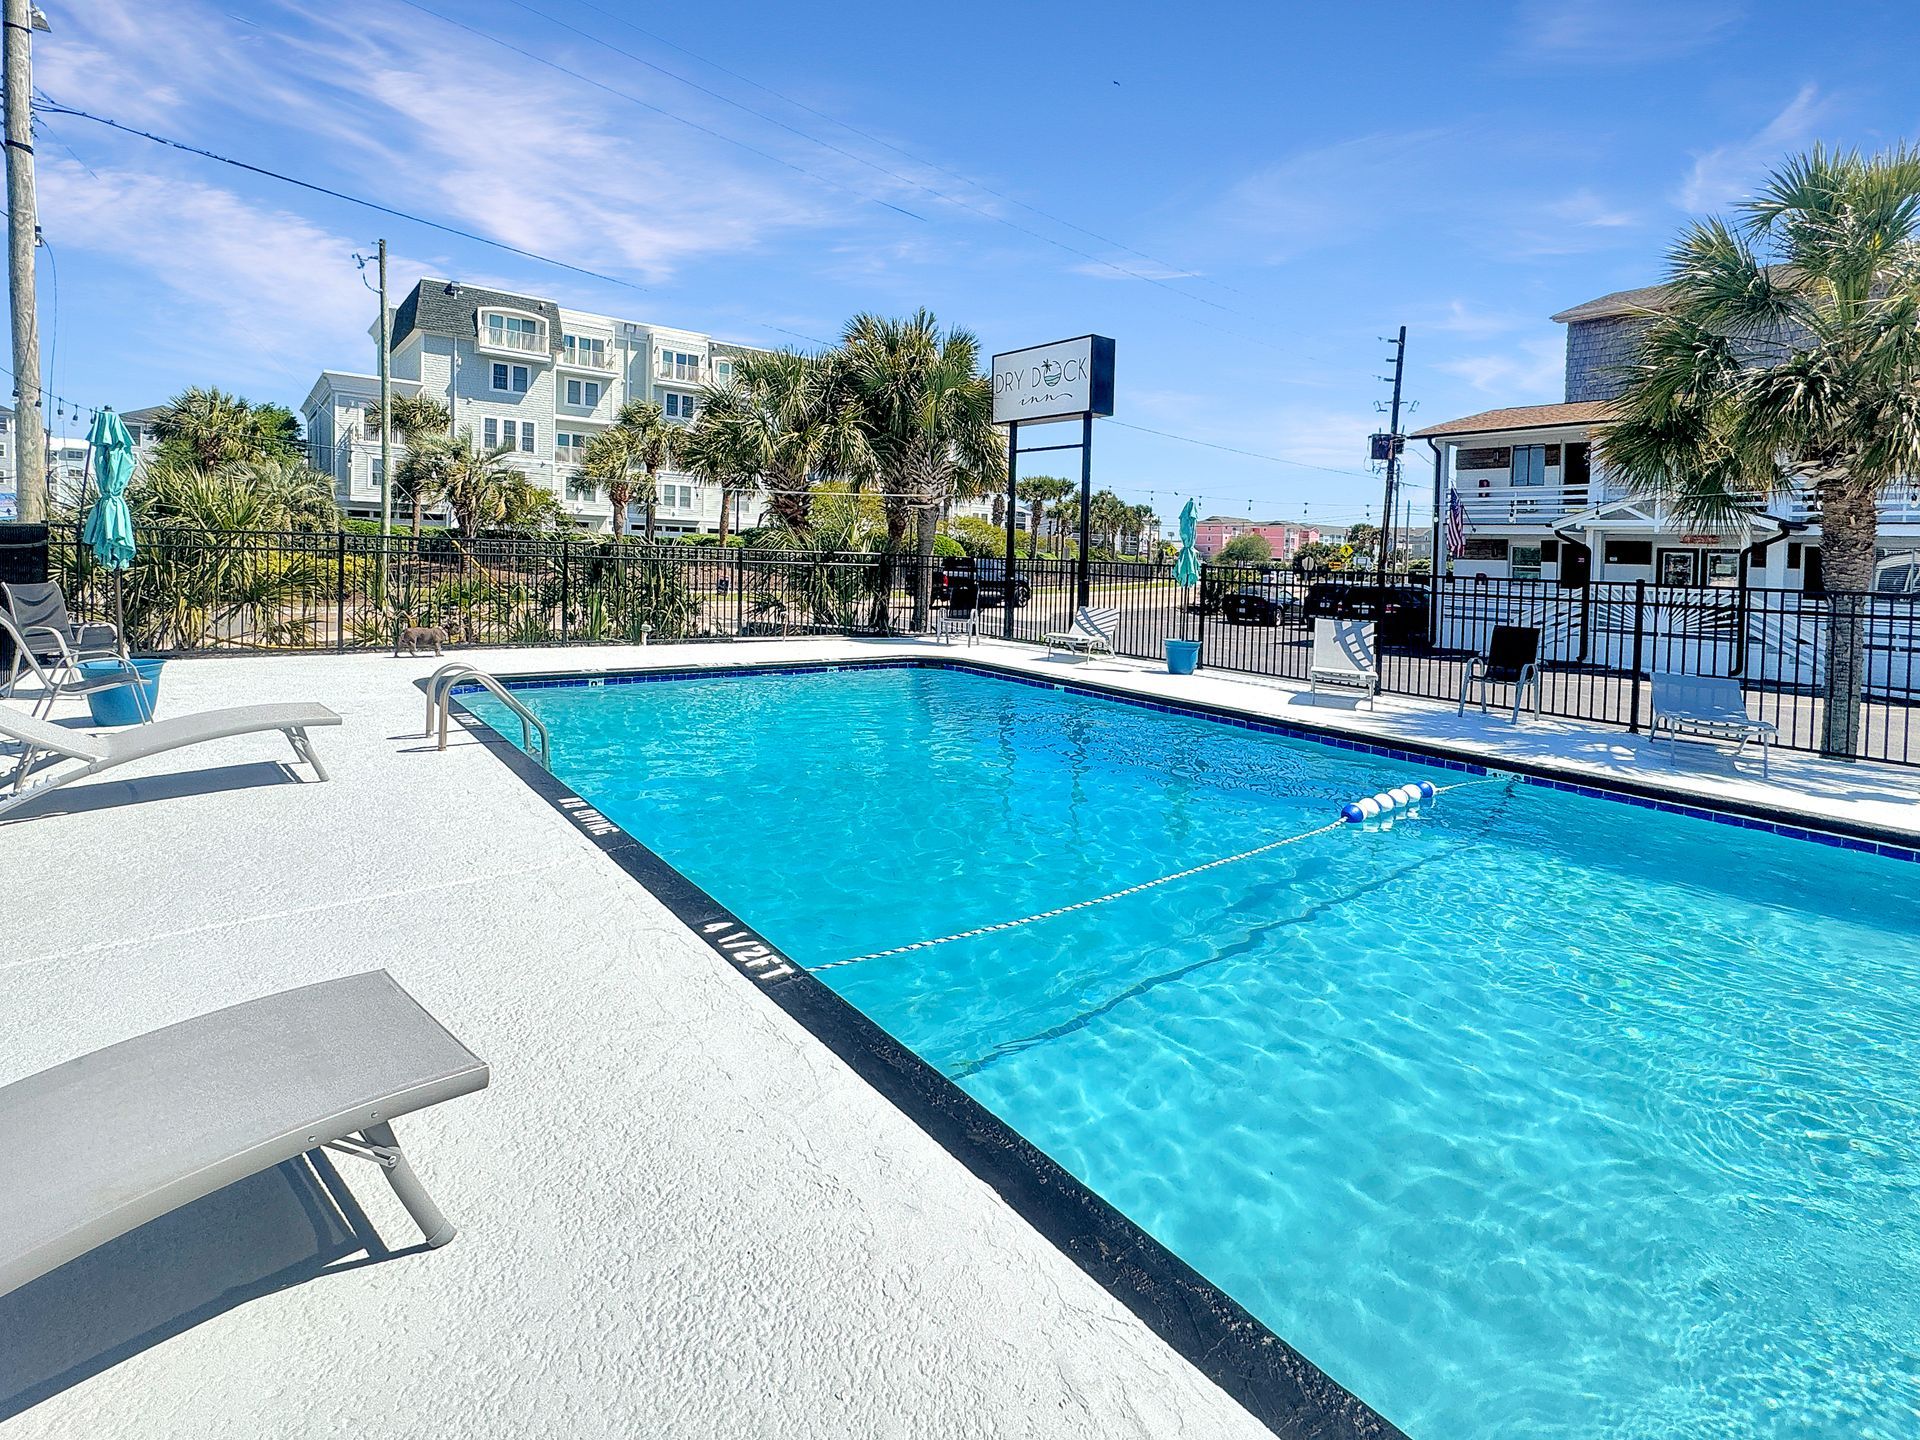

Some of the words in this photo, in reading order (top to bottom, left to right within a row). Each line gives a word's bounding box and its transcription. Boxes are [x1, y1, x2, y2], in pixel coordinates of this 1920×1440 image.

[996, 369, 1025, 394] DRY
[1032, 357, 1088, 388] DOCK
[1018, 392, 1073, 406] inn
[572, 809, 620, 836] DIVING
[703, 921, 734, 933] 4
[717, 931, 796, 980] 1/2FT
